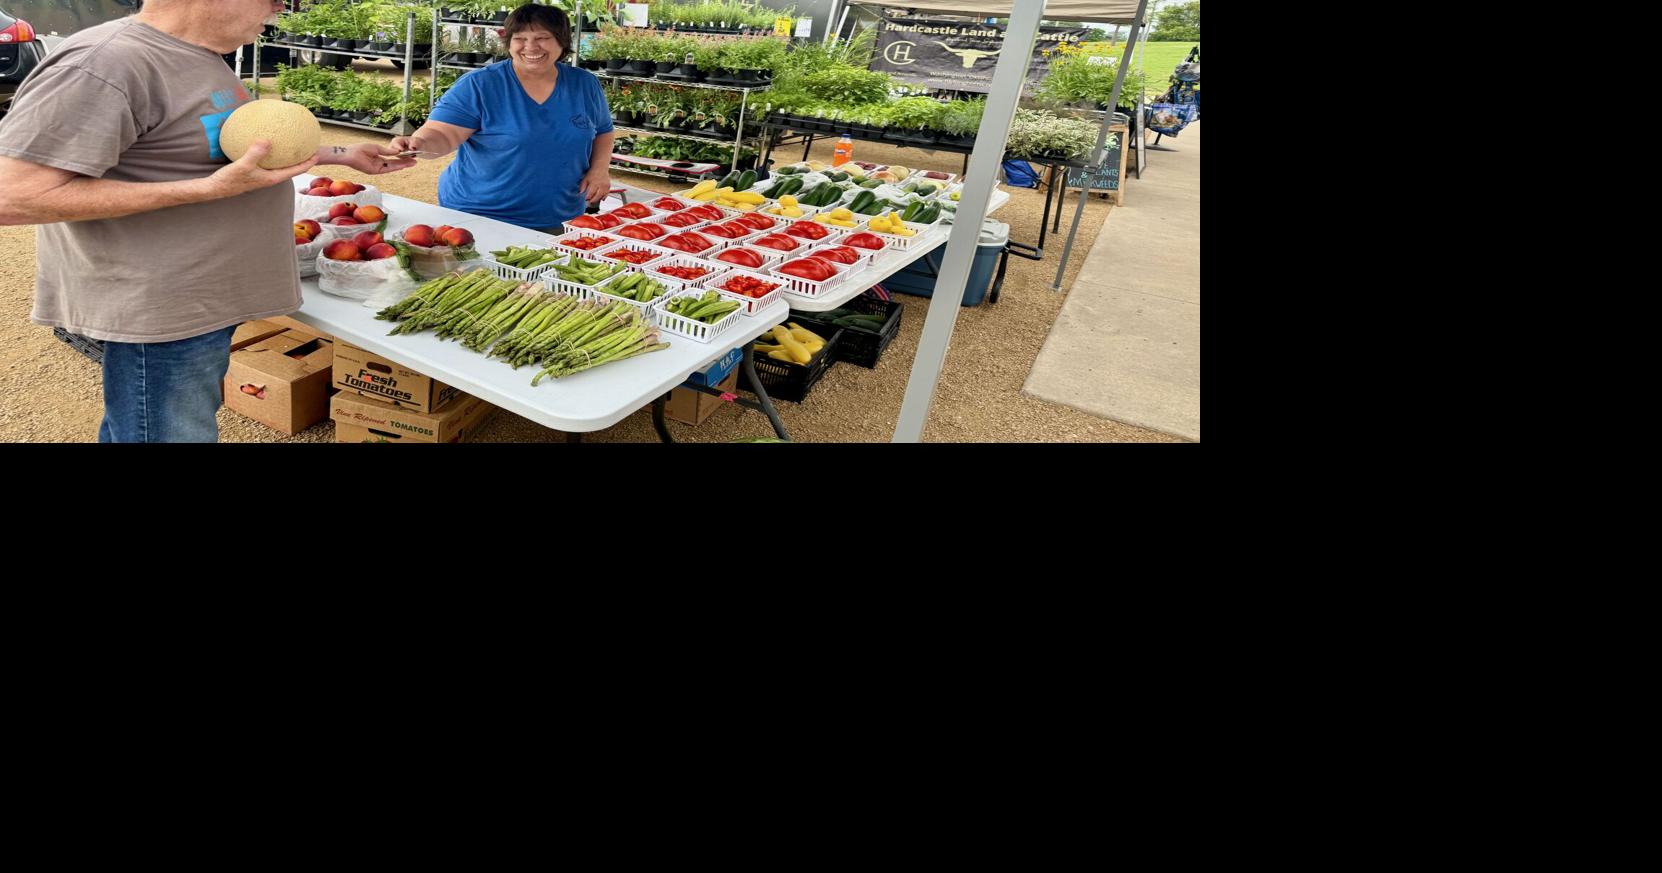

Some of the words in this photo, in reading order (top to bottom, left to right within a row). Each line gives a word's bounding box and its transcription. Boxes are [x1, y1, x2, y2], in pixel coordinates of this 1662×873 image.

[885, 23, 958, 35] Hardcastle
[961, 28, 997, 38] Land
[345, 373, 413, 401] Tomatoes
[358, 369, 398, 388] Fresh
[390, 420, 434, 436] TOMATOES
